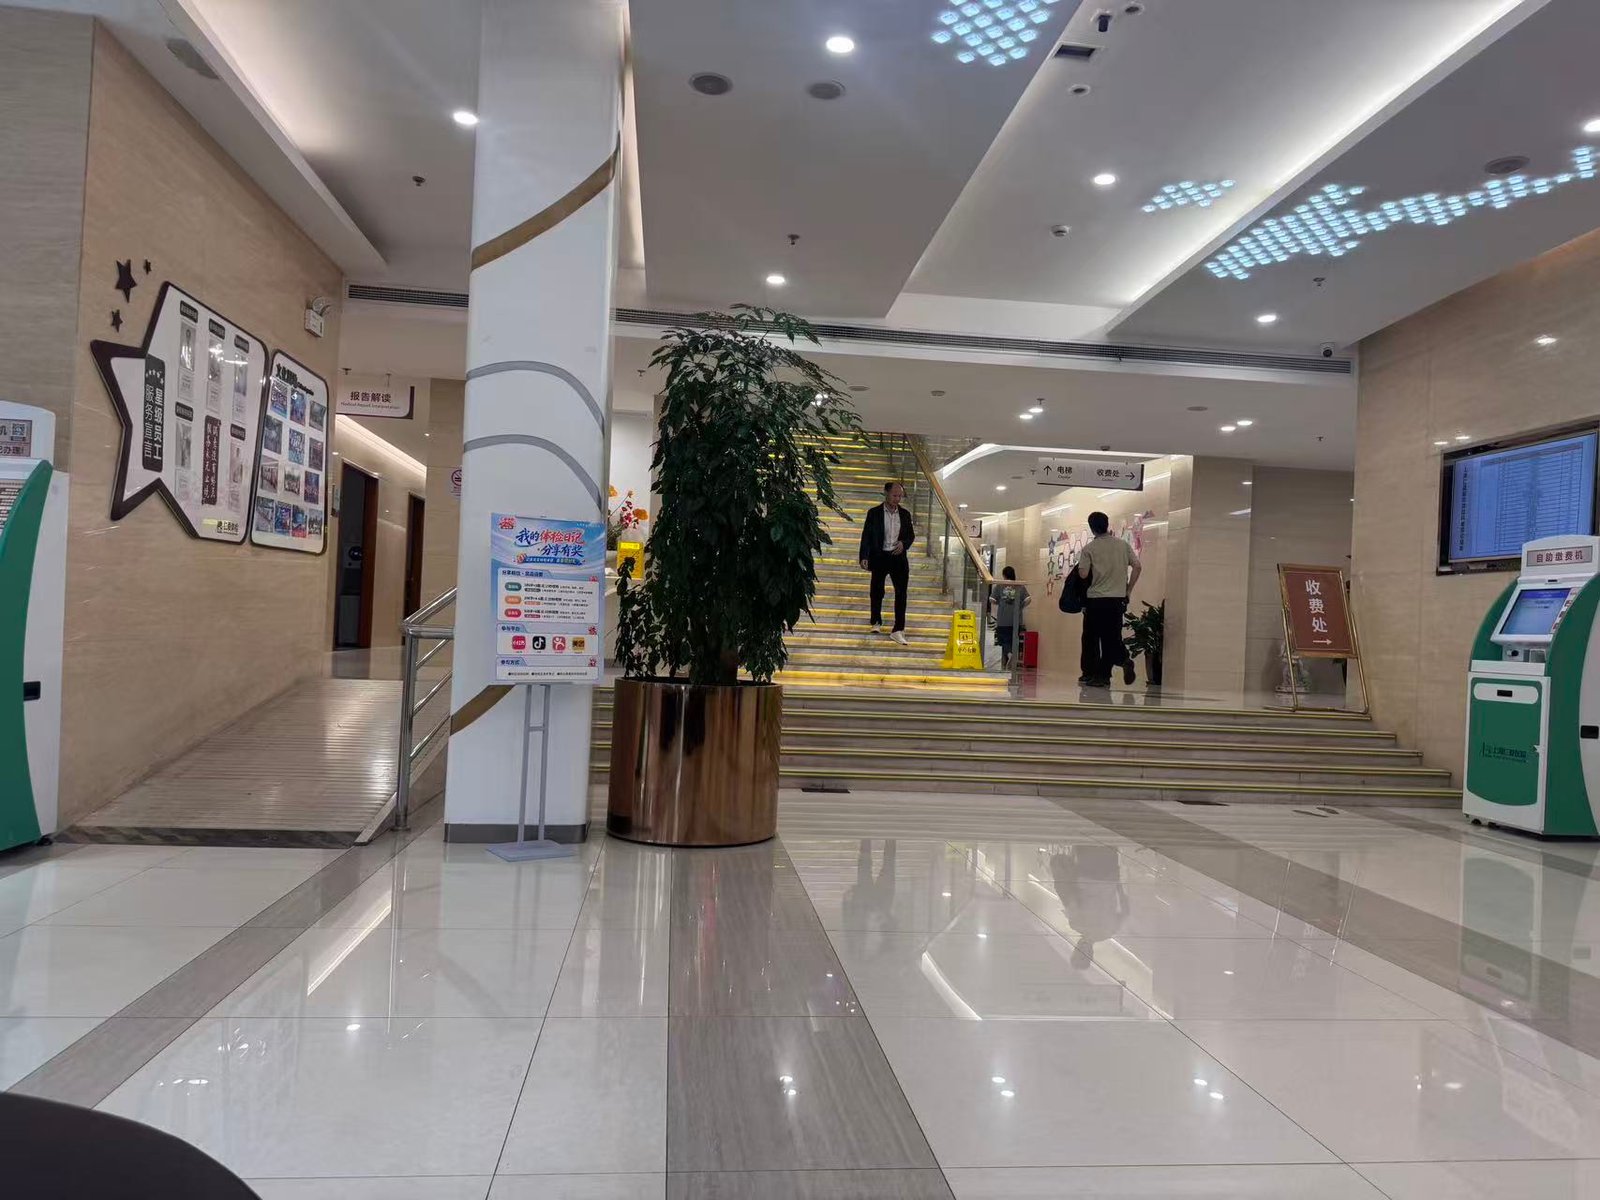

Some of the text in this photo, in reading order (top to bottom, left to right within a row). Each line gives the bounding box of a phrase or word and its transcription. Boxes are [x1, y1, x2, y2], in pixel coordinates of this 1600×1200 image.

[350, 391, 391, 403] 报告解读
[144, 383, 154, 458] 服务宣言
[153, 387, 163, 460] 星级员工
[1057, 466, 1073, 474] 电梯
[1096, 468, 1120, 478] 收费处
[540, 543, 584, 557] 分享有奖
[1536, 550, 1583, 563] 自助缴费机
[1305, 579, 1328, 633] 收费处
